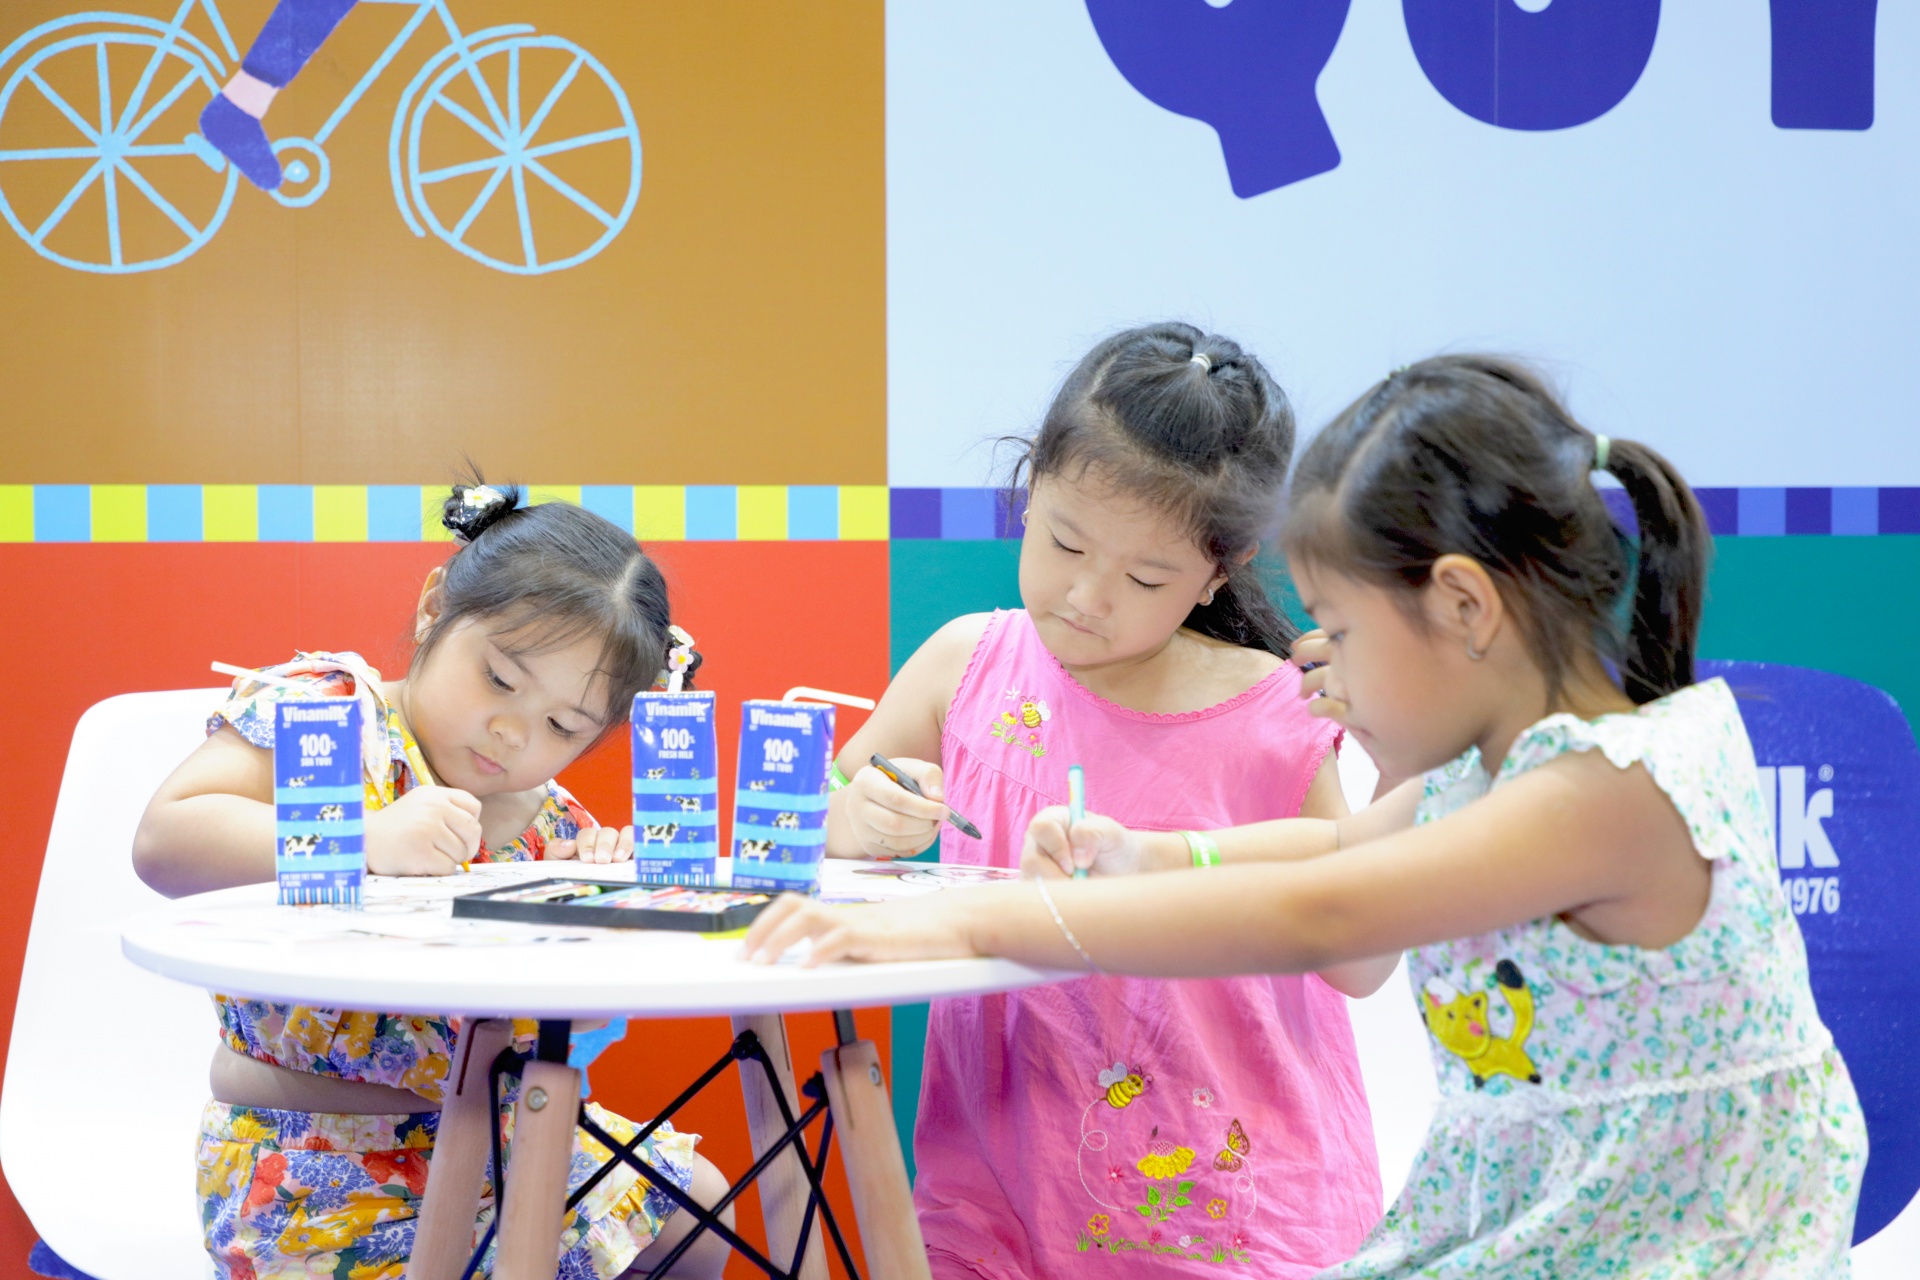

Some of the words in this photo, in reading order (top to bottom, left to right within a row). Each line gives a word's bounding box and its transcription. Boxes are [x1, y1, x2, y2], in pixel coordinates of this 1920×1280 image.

[282, 704, 352, 722] Vinamilk
[645, 701, 711, 717] Vinamilk
[1781, 877, 1841, 915] 1976
